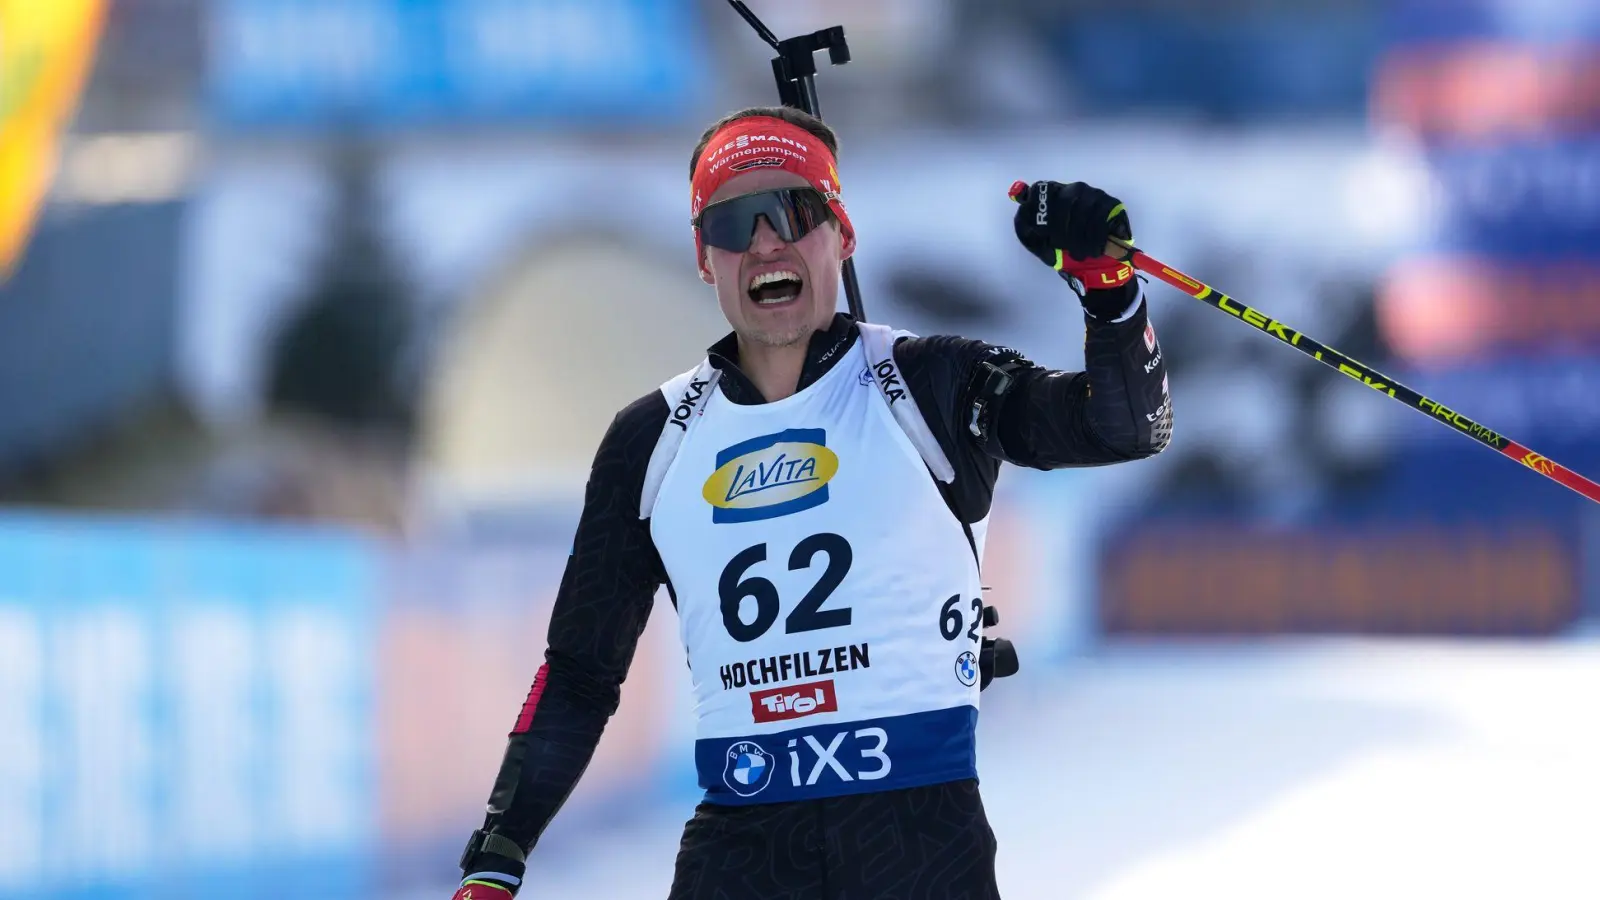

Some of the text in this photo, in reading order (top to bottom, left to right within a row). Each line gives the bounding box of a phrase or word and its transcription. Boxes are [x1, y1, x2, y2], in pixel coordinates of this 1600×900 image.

[707, 134, 808, 163] VIESSMANN
[1036, 181, 1048, 225] ROEC
[1101, 266, 1134, 284] LE
[1218, 294, 1303, 346] LEKI
[670, 380, 710, 431] JOKA
[872, 358, 905, 406] JOKA
[718, 532, 853, 642] 62
[939, 593, 983, 644] 62
[720, 643, 871, 690] HOCHFILZEN
[760, 688, 826, 714] Tirol
[729, 744, 764, 760] BMW
[787, 727, 892, 787] iX3
